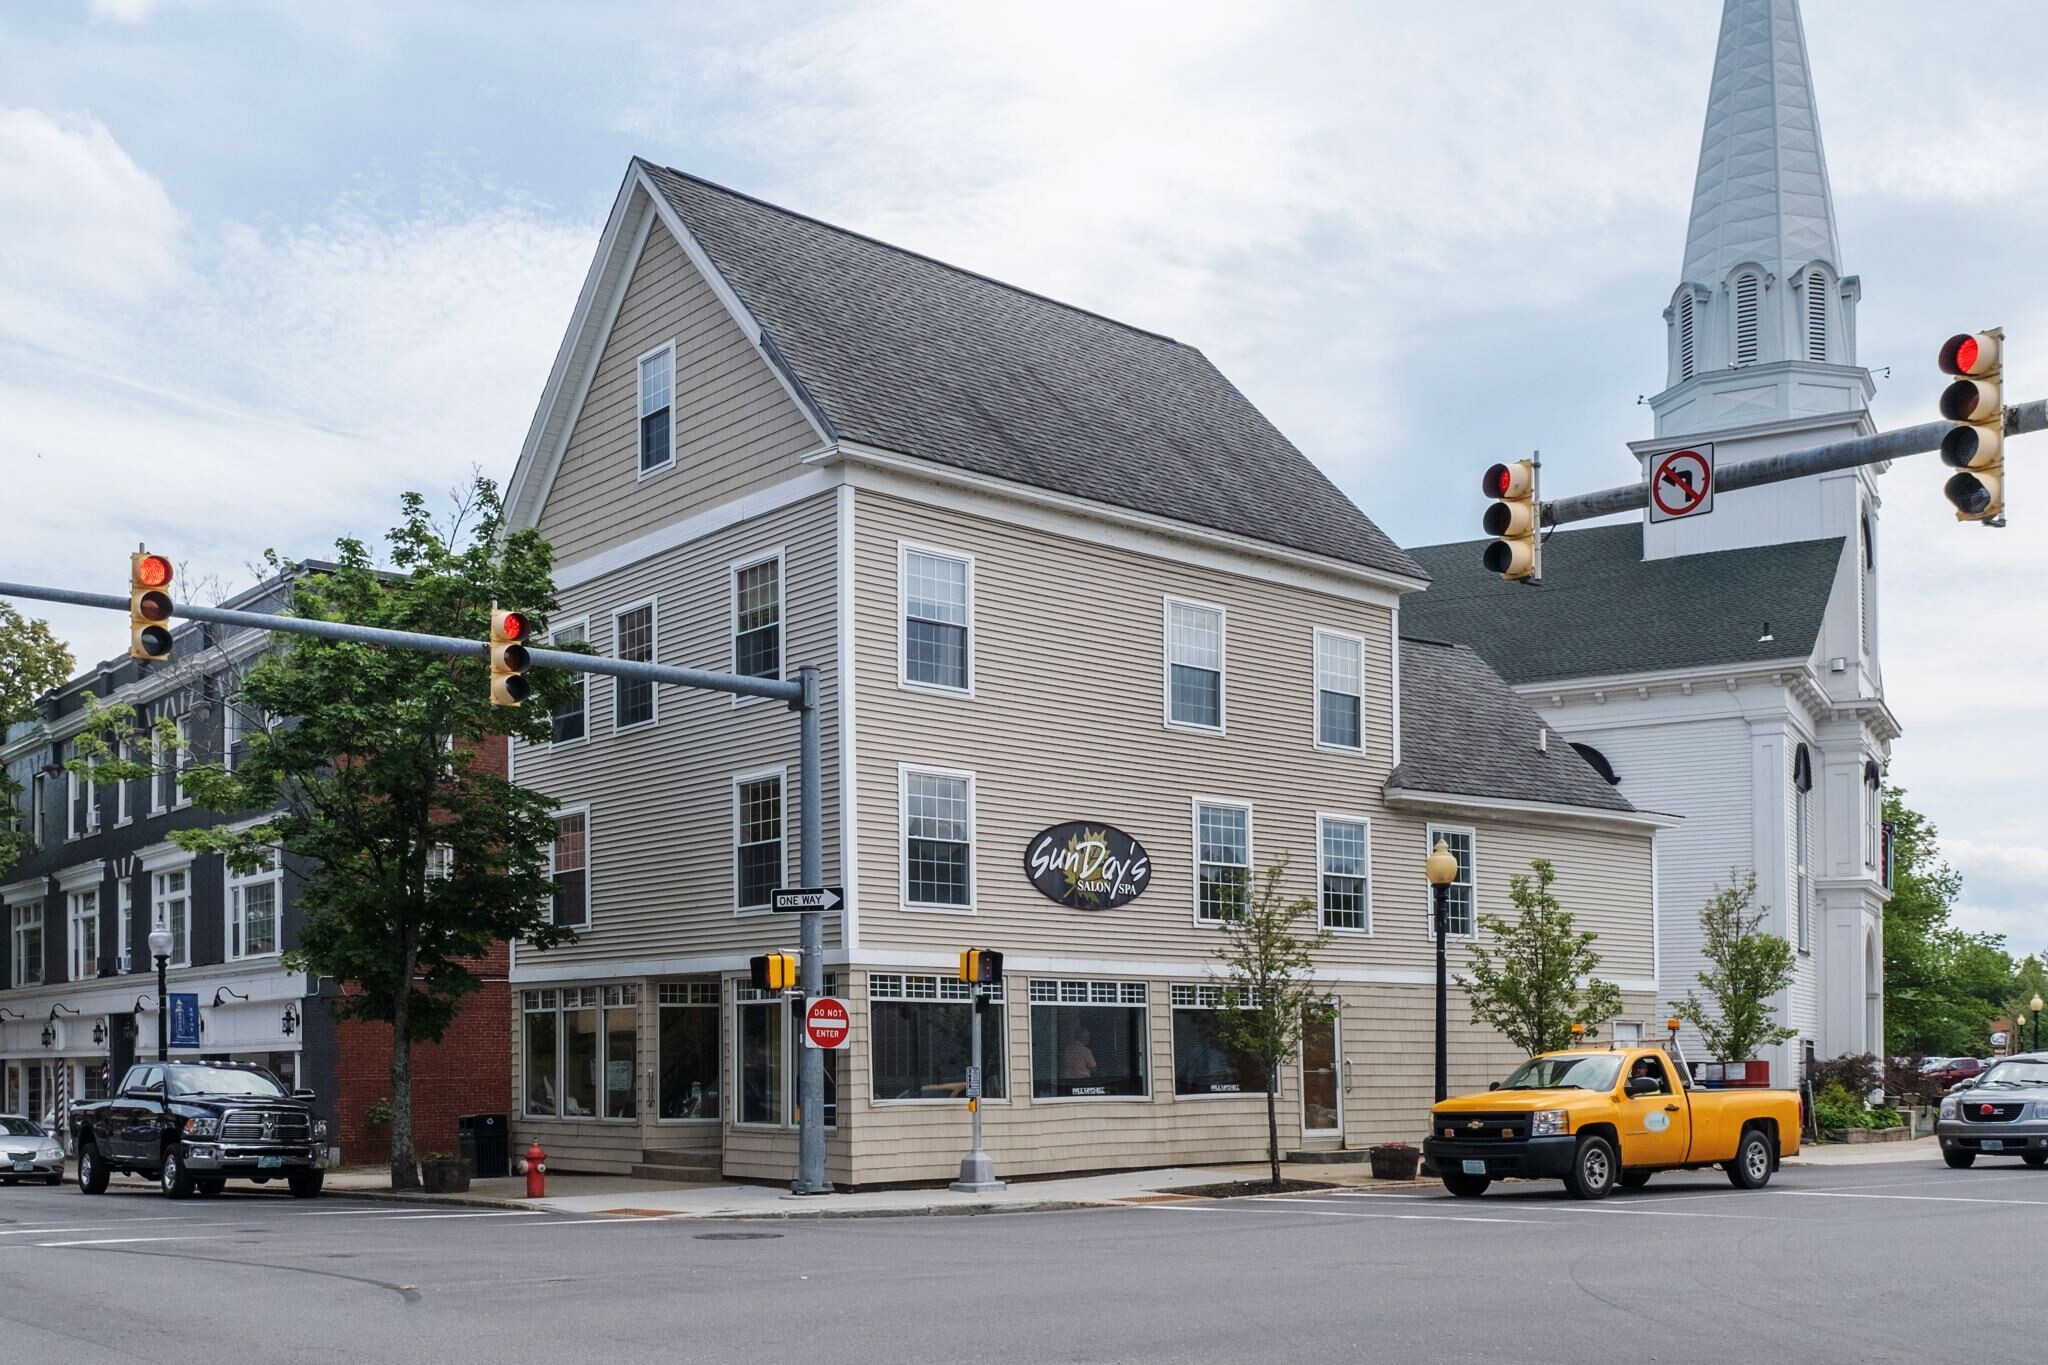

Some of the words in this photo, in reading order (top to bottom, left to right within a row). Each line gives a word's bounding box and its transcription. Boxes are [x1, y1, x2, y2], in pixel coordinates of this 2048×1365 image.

[1031, 836, 1147, 899] SunDay's
[1077, 880, 1111, 893] SALON
[1118, 883, 1136, 895] SPA
[779, 896, 798, 905] ONE
[802, 895, 822, 904] WAY
[814, 1008, 825, 1016] DO
[827, 1009, 842, 1017] NOT
[816, 1029, 839, 1038] ENTER
